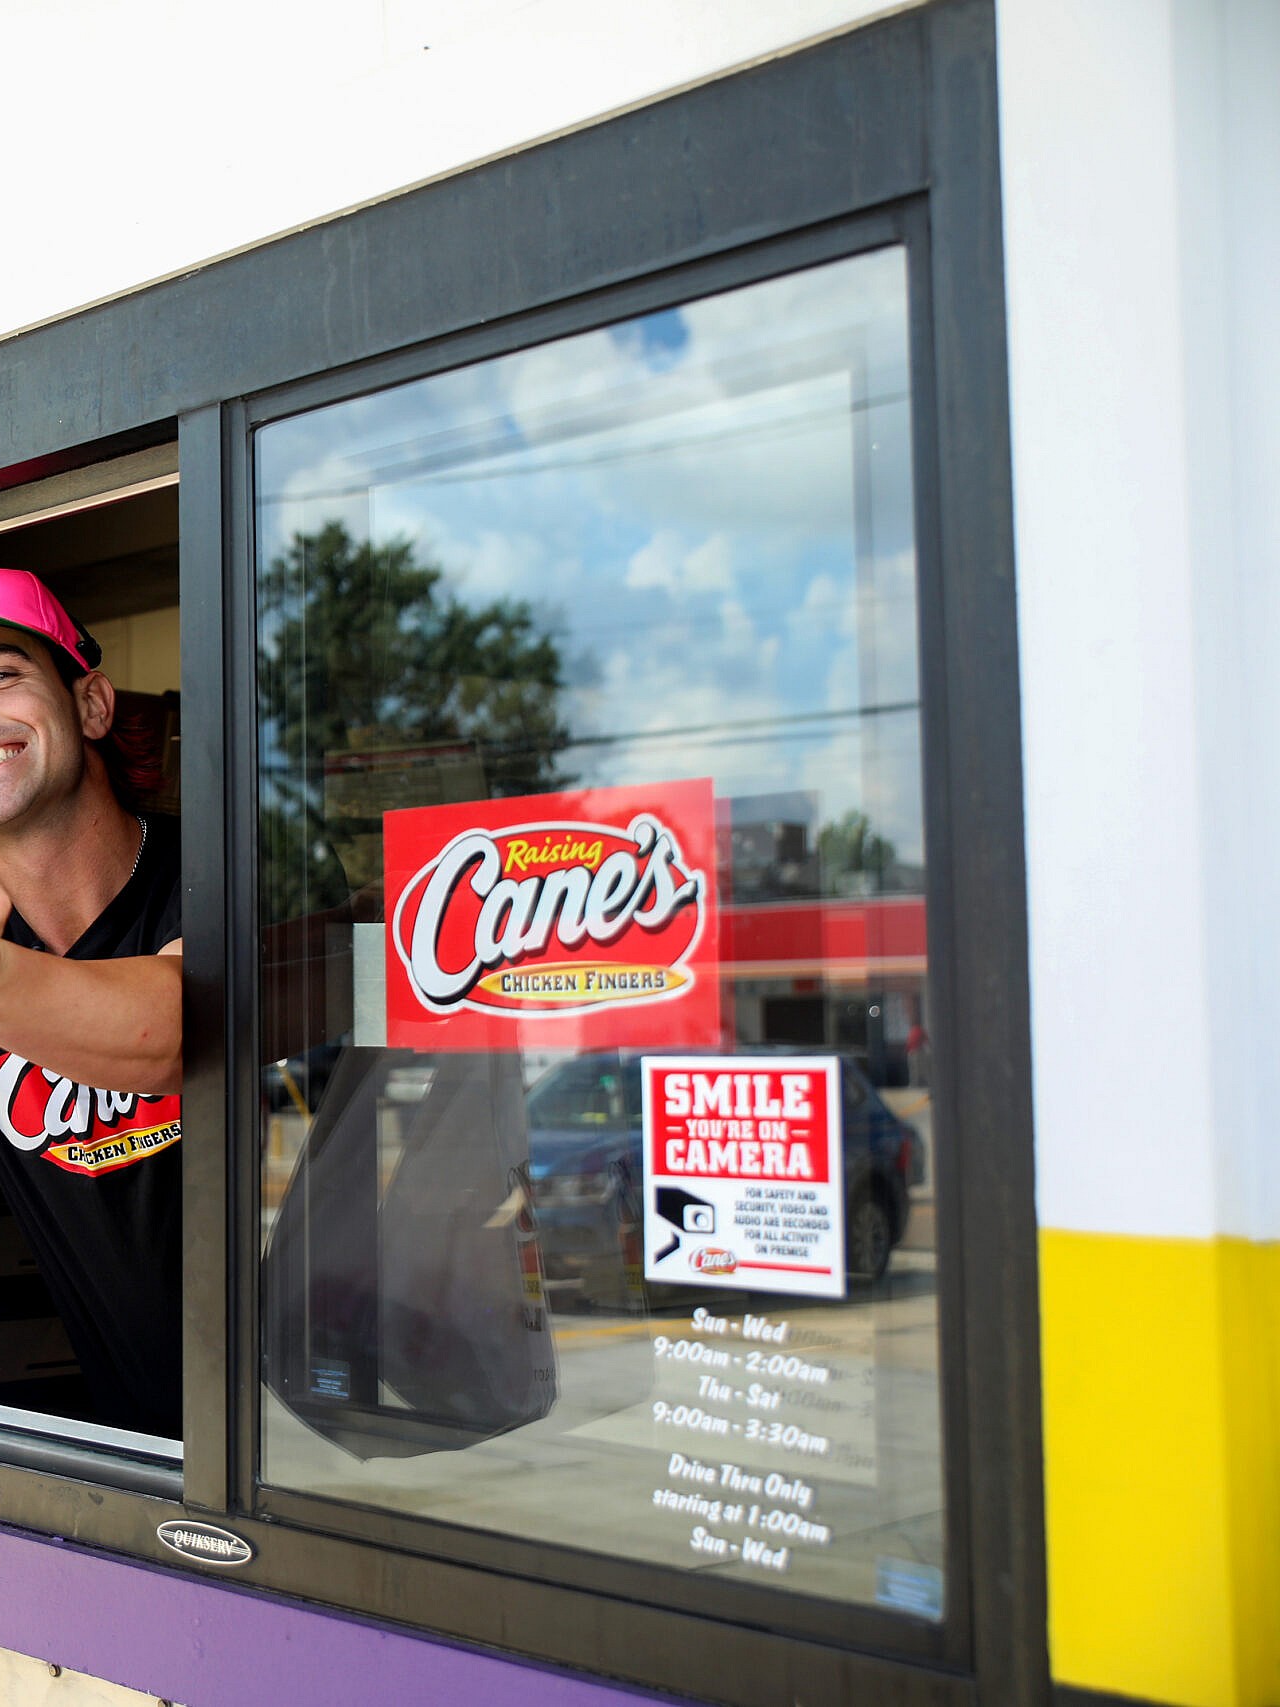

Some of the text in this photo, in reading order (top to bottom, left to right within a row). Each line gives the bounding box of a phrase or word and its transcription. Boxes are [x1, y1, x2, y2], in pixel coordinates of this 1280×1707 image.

[504, 835, 603, 872] Raising
[411, 822, 698, 1001] Cane's
[501, 970, 665, 992] CHICKEN FINGERS
[664, 1074, 812, 1119] SMILE
[686, 1119, 787, 1140] YOU'RE ON
[666, 1139, 813, 1177] CAMERA
[745, 1187, 816, 1201] FOR SAFETY AND
[780, 1204, 806, 1214] VIDEO
[809, 1205, 828, 1216] AND
[734, 1215, 830, 1230] AUDIO ARE RECORDED
[744, 1229, 819, 1243] FOR ALL ACTIVITY
[755, 1243, 768, 1254] ON
[691, 1307, 726, 1334] Sun
[742, 1314, 788, 1343] Wed
[654, 1336, 729, 1367] 9:00am
[745, 1351, 829, 1383] 2:00am
[699, 1375, 730, 1401] Thu
[746, 1383, 781, 1410] Sat
[652, 1401, 729, 1434] 9:00am
[744, 1419, 828, 1453] 3:30am
[669, 1454, 812, 1507] Drive Thru Only
[652, 1489, 831, 1543] starting at 1:00am
[174, 1530, 234, 1555] QUIKSERV
[690, 1526, 729, 1555] Sun
[742, 1537, 789, 1570] Wed
